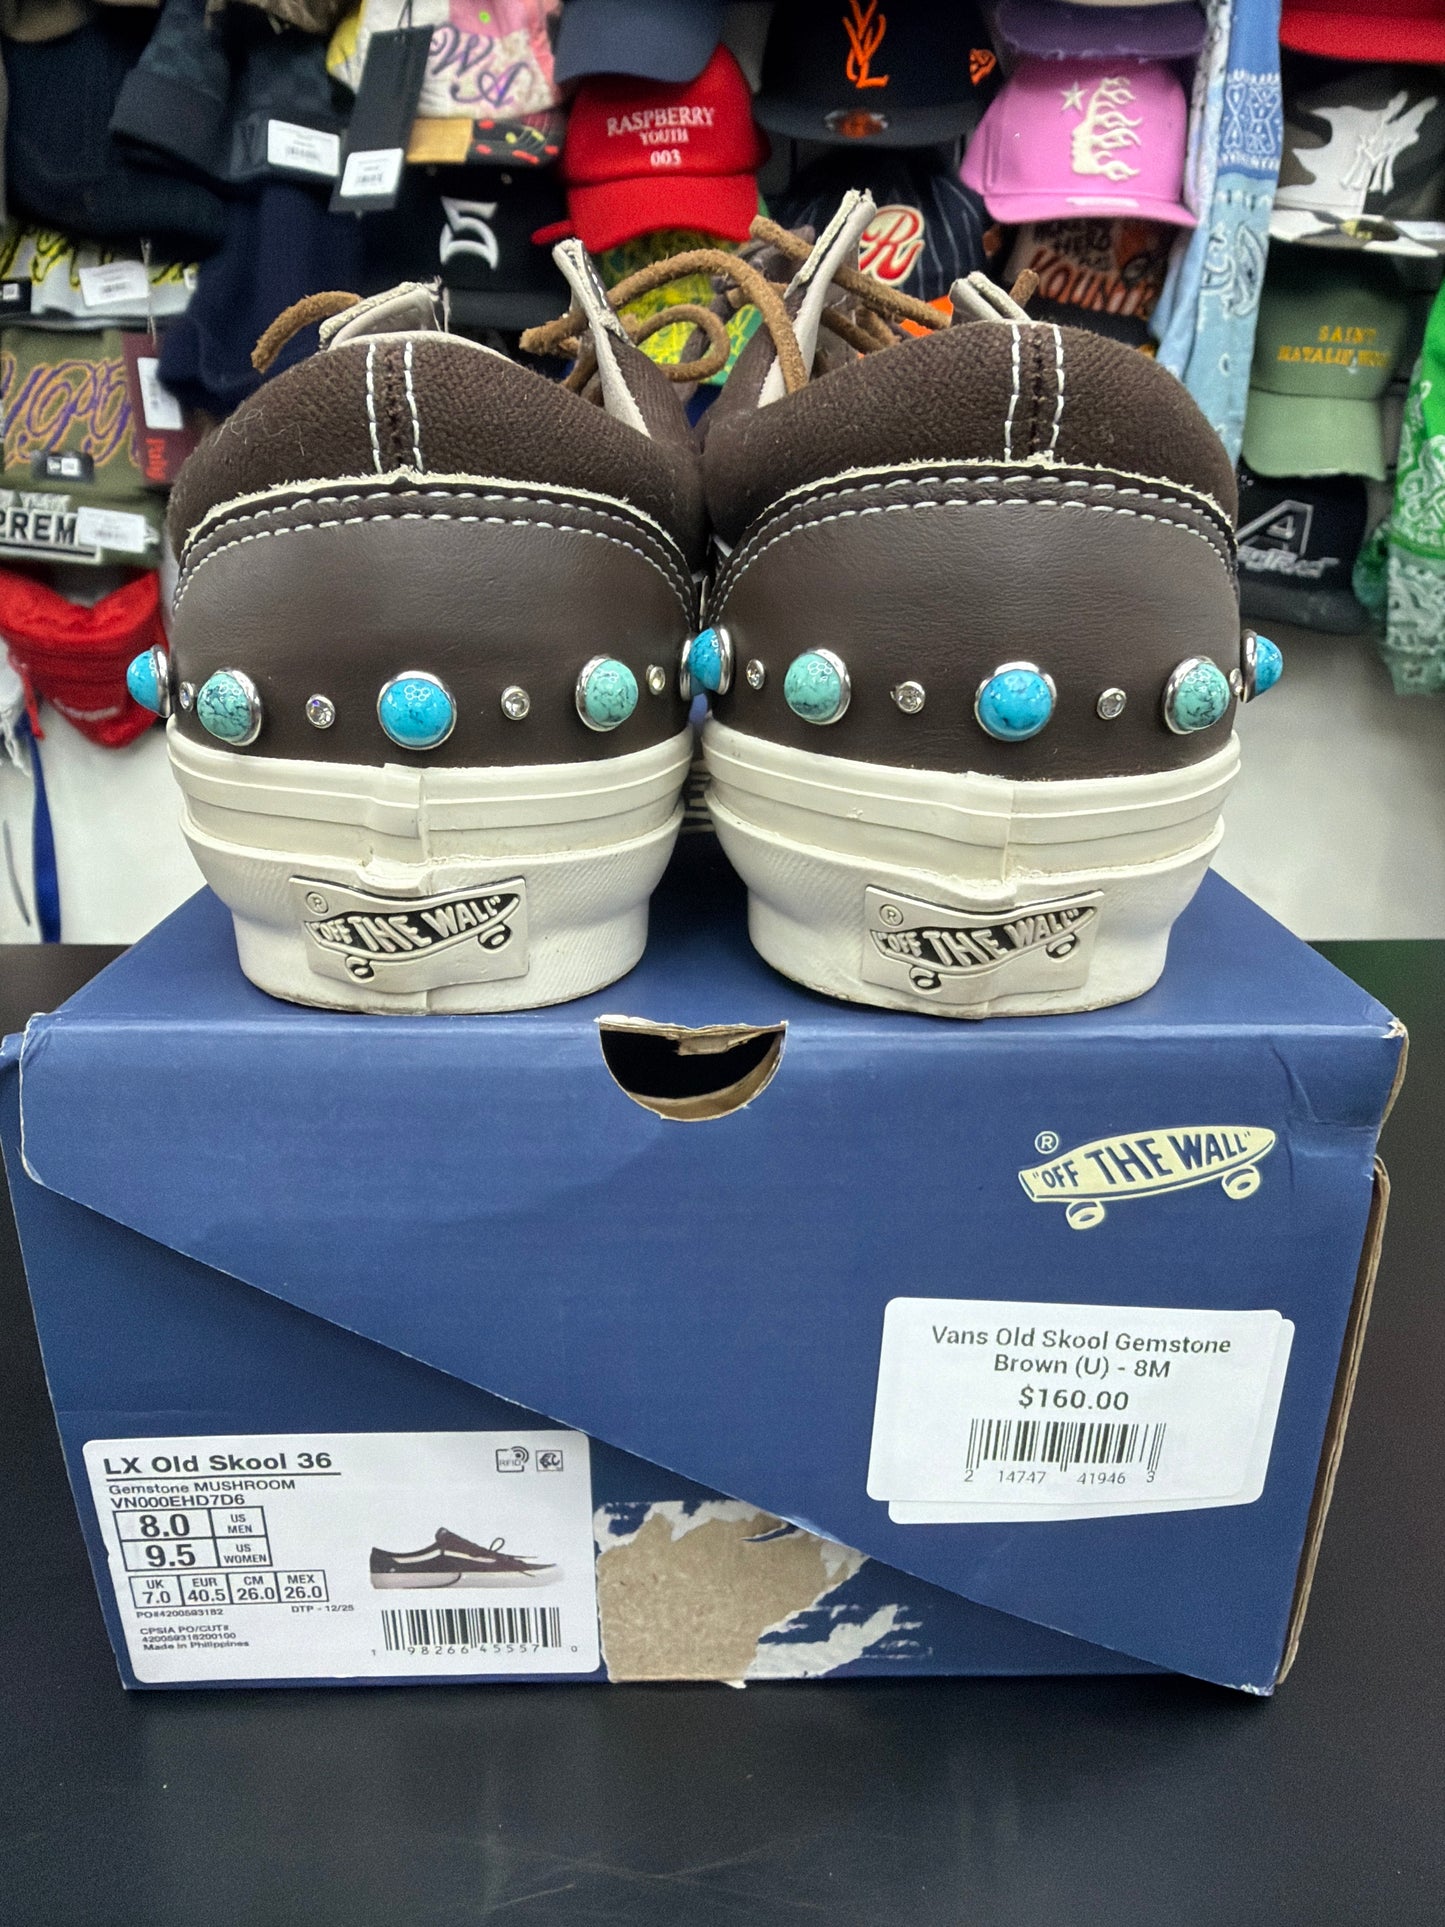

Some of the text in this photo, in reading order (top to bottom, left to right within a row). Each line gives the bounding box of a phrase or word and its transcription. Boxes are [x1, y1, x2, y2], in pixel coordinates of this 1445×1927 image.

[606, 105, 715, 137] RASPBERRY
[640, 127, 689, 146] YOUTH
[650, 148, 681, 167] 003
[347, 914, 432, 953] THE
[922, 928, 1009, 967] THE
[1084, 1138, 1174, 1185] THE
[931, 1325, 1231, 1354] Vans Old Skool Gemstone
[994, 1353, 1068, 1375] Brown
[1075, 1356, 1109, 1380] (U)
[1133, 1359, 1171, 1379] 8M
[1018, 1384, 1130, 1411] $160.00
[103, 1452, 332, 1474] LX Old Skool 36
[963, 1469, 1156, 1485] 2 14747 41946 3
[109, 1479, 296, 1495] Gemstone MUSHROOM
[110, 1493, 245, 1509] VN000EHD7D6
[138, 1513, 191, 1538] 8.0
[230, 1513, 246, 1524] US
[227, 1524, 253, 1534] MEN
[145, 1543, 196, 1568] 9.5
[235, 1543, 251, 1553] US
[223, 1554, 267, 1565] WOMEN
[146, 1574, 315, 1589] UK EUR CM MEX
[142, 1585, 323, 1605] 7.0 40.5 26.0 26.0
[291, 1604, 314, 1614] DTP
[139, 1626, 176, 1635] CPSIA
[143, 1639, 250, 1651] Made in Philippines
